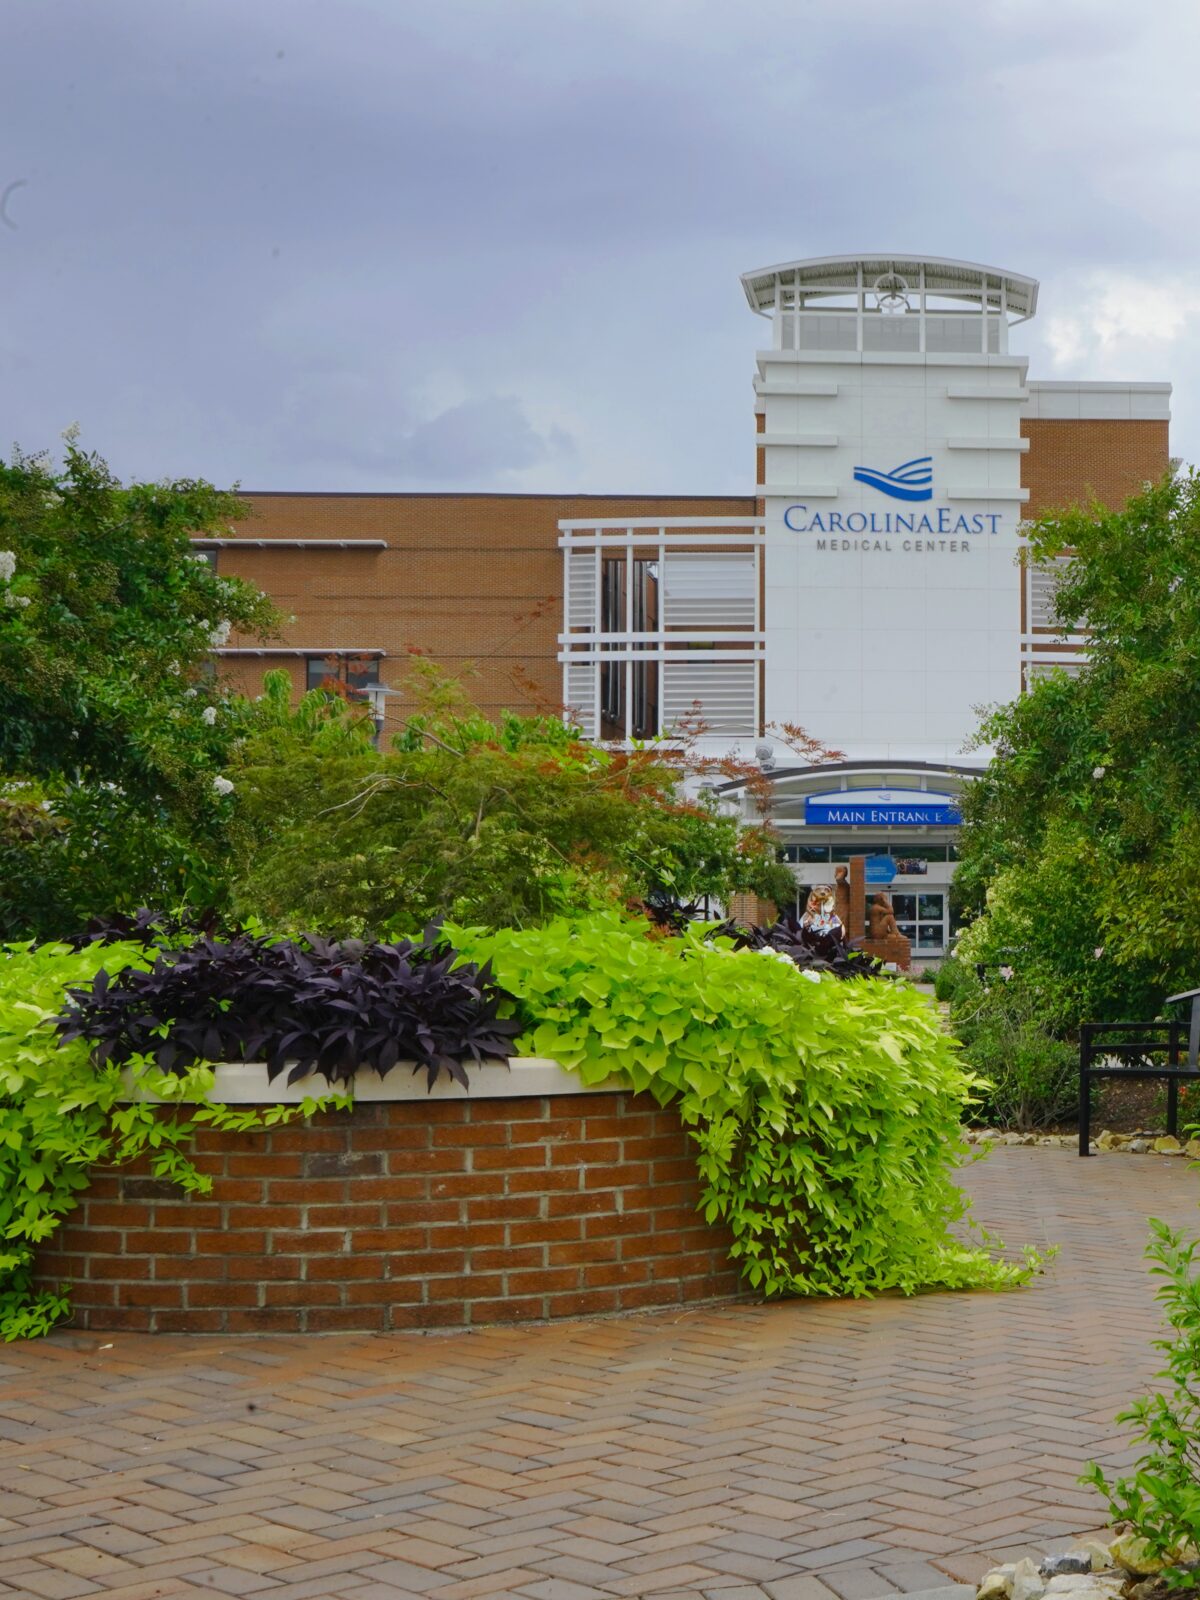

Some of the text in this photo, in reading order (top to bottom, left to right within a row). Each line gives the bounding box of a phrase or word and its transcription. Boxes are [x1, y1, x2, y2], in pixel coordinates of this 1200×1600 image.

[817, 539, 970, 552] MEDICAL CENTER
[828, 811, 865, 822] MAIN
